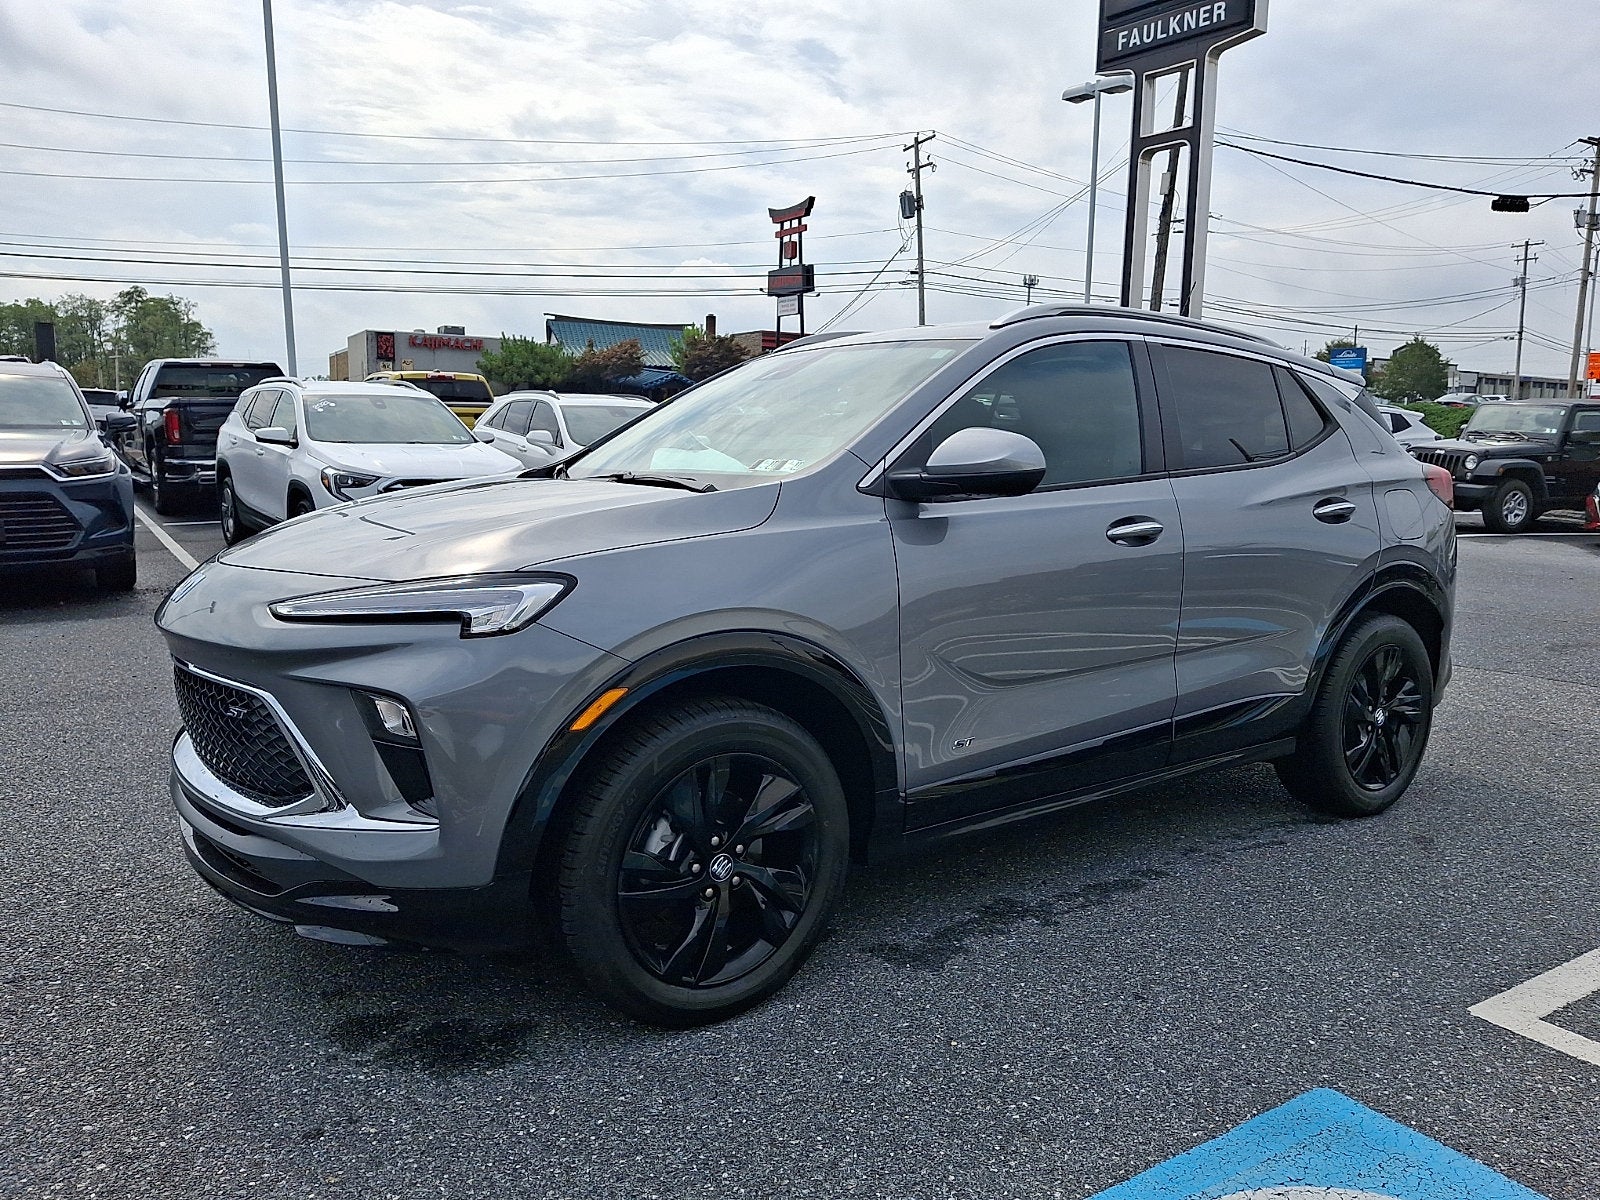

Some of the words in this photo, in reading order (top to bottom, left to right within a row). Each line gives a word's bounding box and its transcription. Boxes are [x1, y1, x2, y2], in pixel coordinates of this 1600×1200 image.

[1117, 1, 1226, 51] FAULKNER
[226, 706, 247, 718] ST
[952, 736, 976, 750] ST
